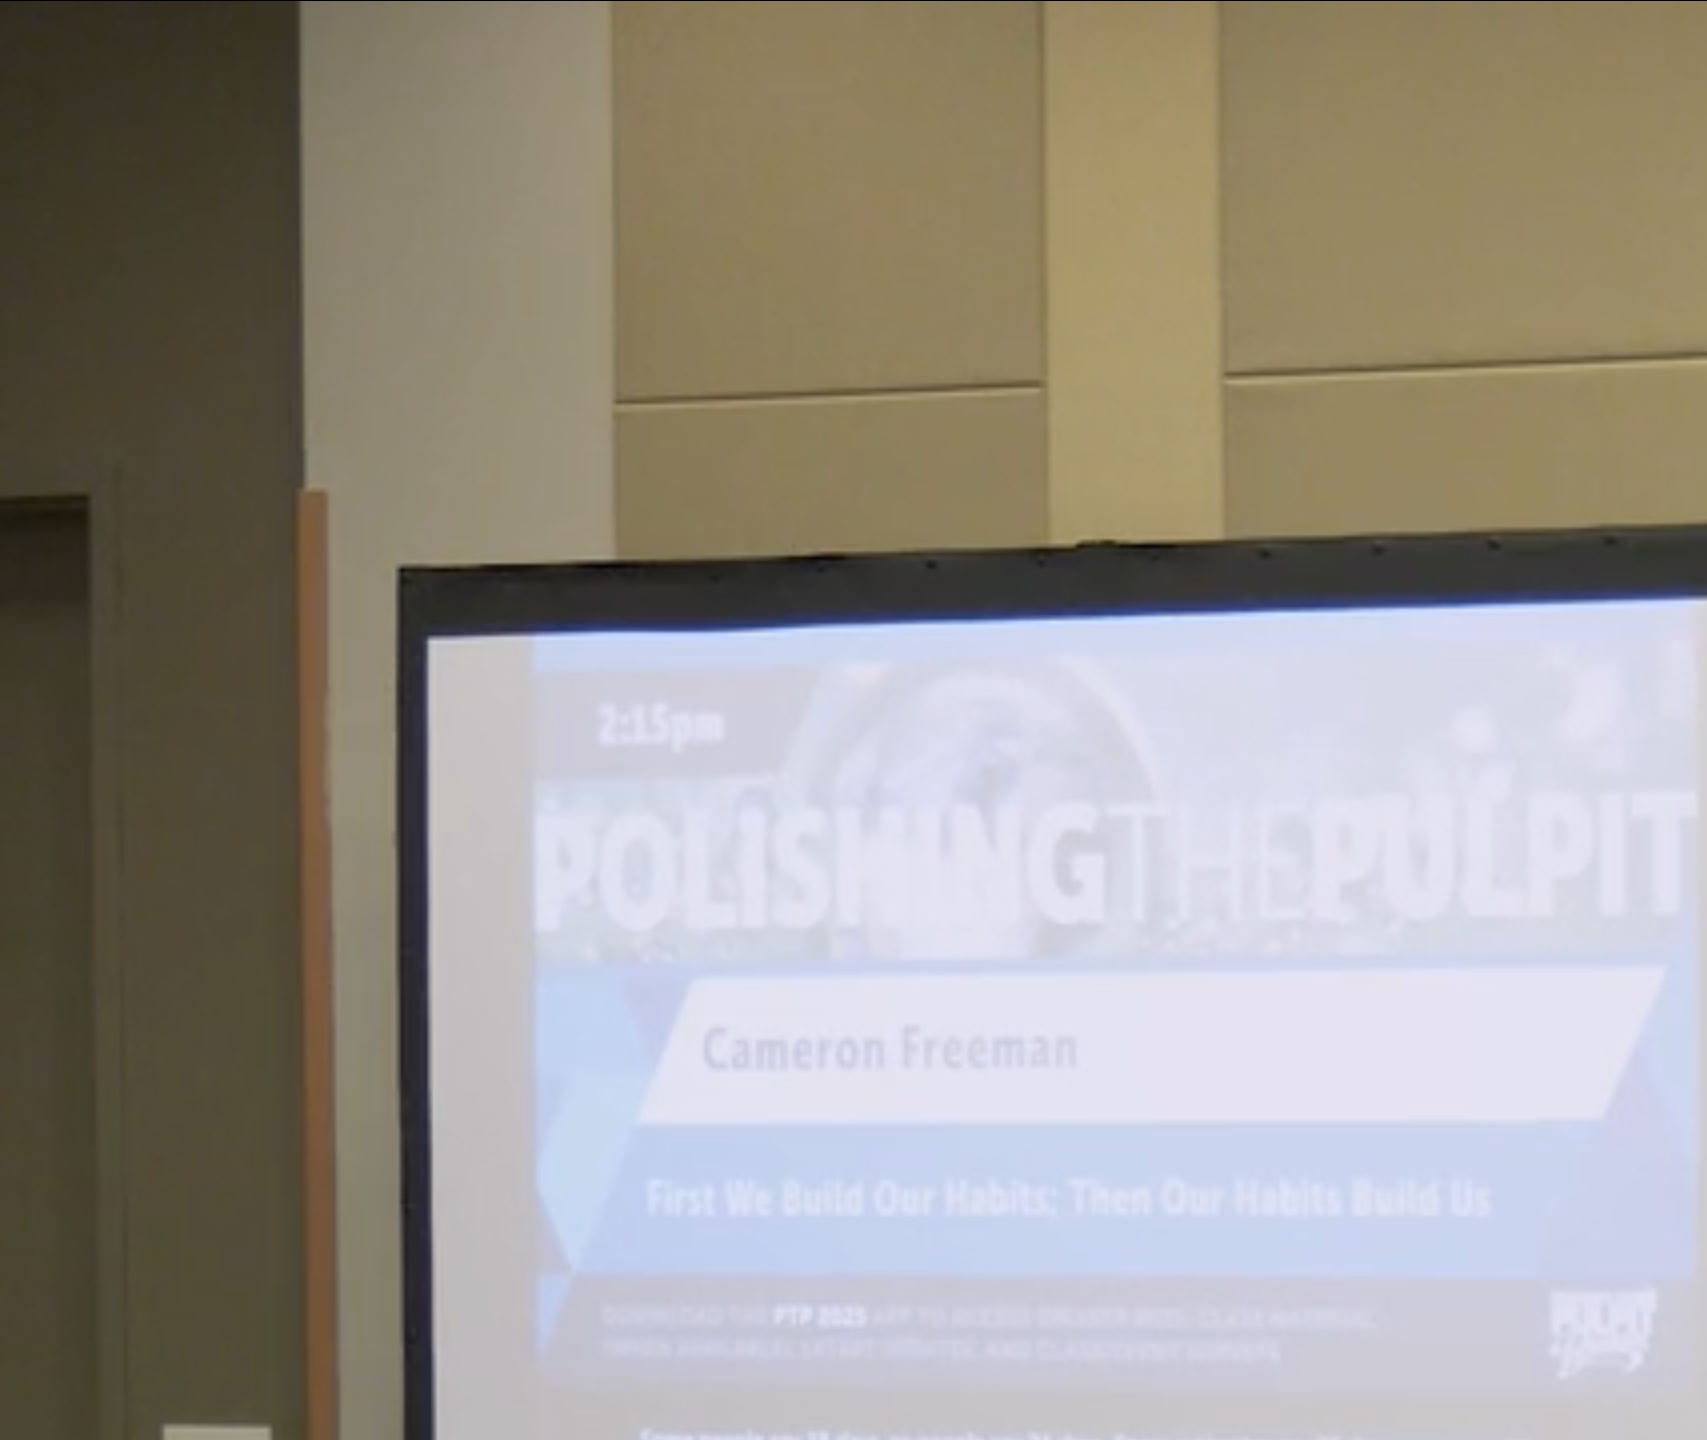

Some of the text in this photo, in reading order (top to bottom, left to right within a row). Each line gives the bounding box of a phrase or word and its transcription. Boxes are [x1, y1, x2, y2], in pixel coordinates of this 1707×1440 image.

[597, 703, 726, 753] 2:15pm
[702, 1023, 1078, 1072] Cameron Freeman
[646, 1178, 717, 1218] First
[723, 1178, 773, 1217] We
[782, 1178, 866, 1217] Build
[874, 1178, 937, 1217] Our
[1067, 1178, 1152, 1217] Then
[1160, 1178, 1226, 1217] Our
[1234, 1176, 1344, 1218] Habits
[1350, 1177, 1441, 1217] Build
[1449, 1178, 1493, 1217] Us
[773, 1304, 814, 1327] PTP
